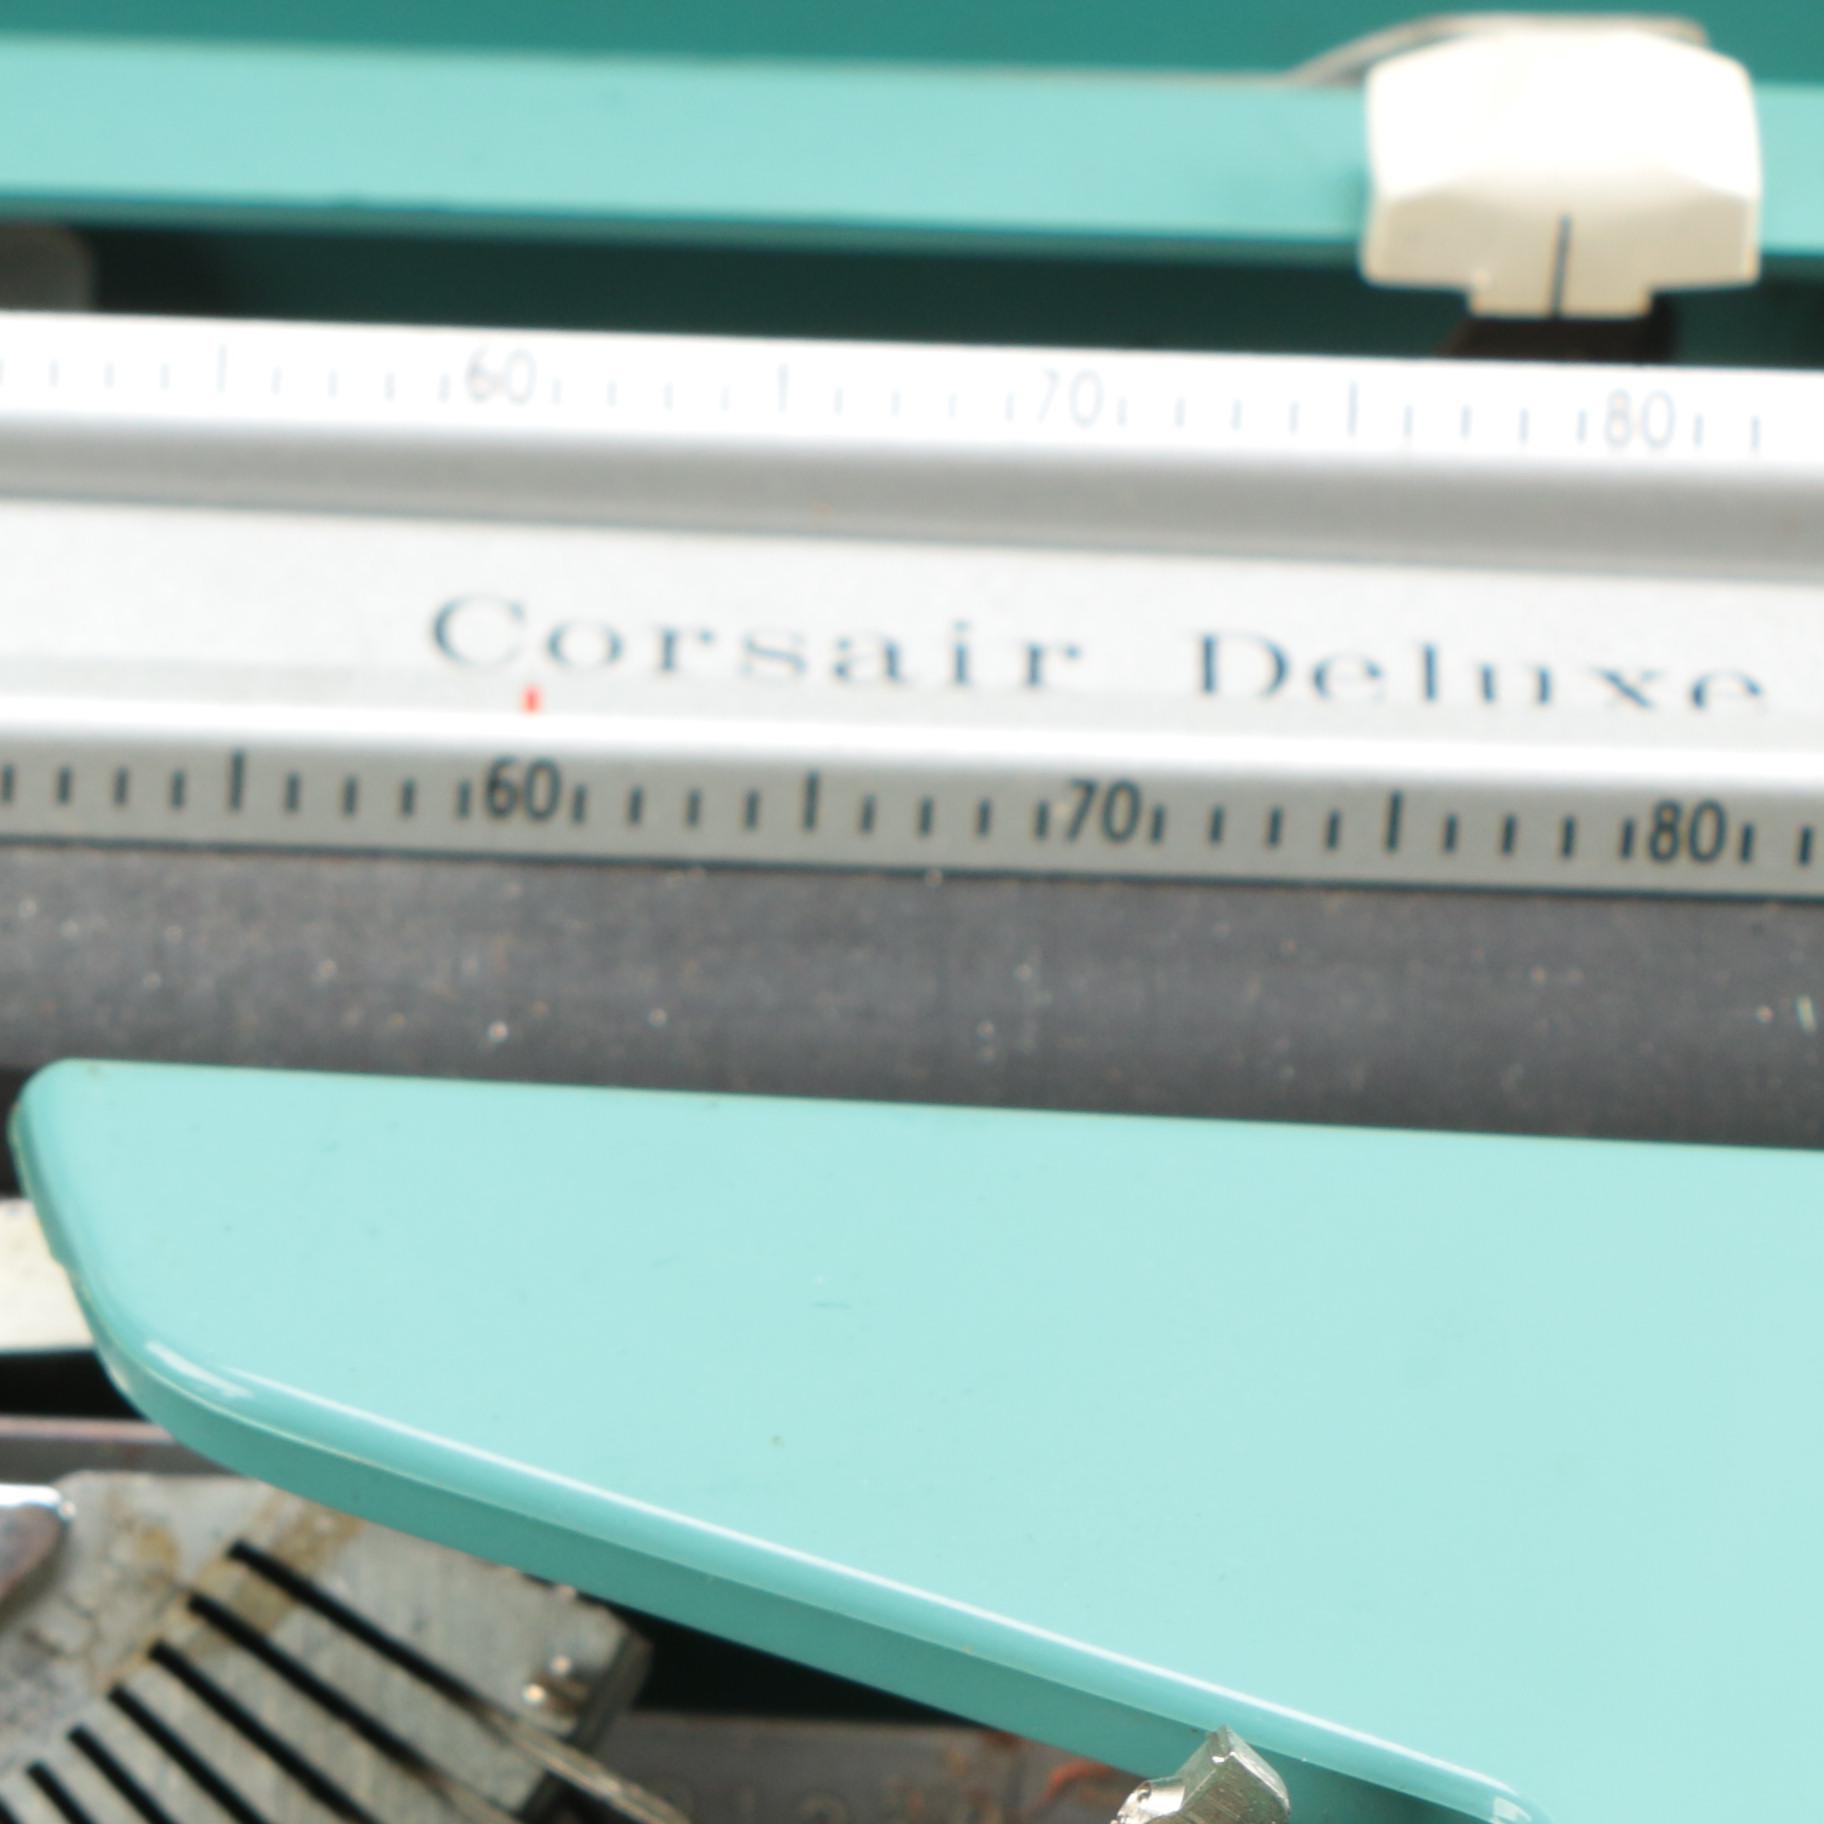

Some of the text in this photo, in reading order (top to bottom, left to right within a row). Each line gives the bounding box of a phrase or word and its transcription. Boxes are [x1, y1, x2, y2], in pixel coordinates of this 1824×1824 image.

[464, 344, 536, 406] 60
[1035, 367, 1105, 429] 70
[1601, 388, 1677, 450] 80
[429, 592, 1767, 715] Corsair Deluxe
[484, 758, 562, 822] 60
[1063, 780, 1142, 842] 70
[1650, 800, 1728, 864] 80
